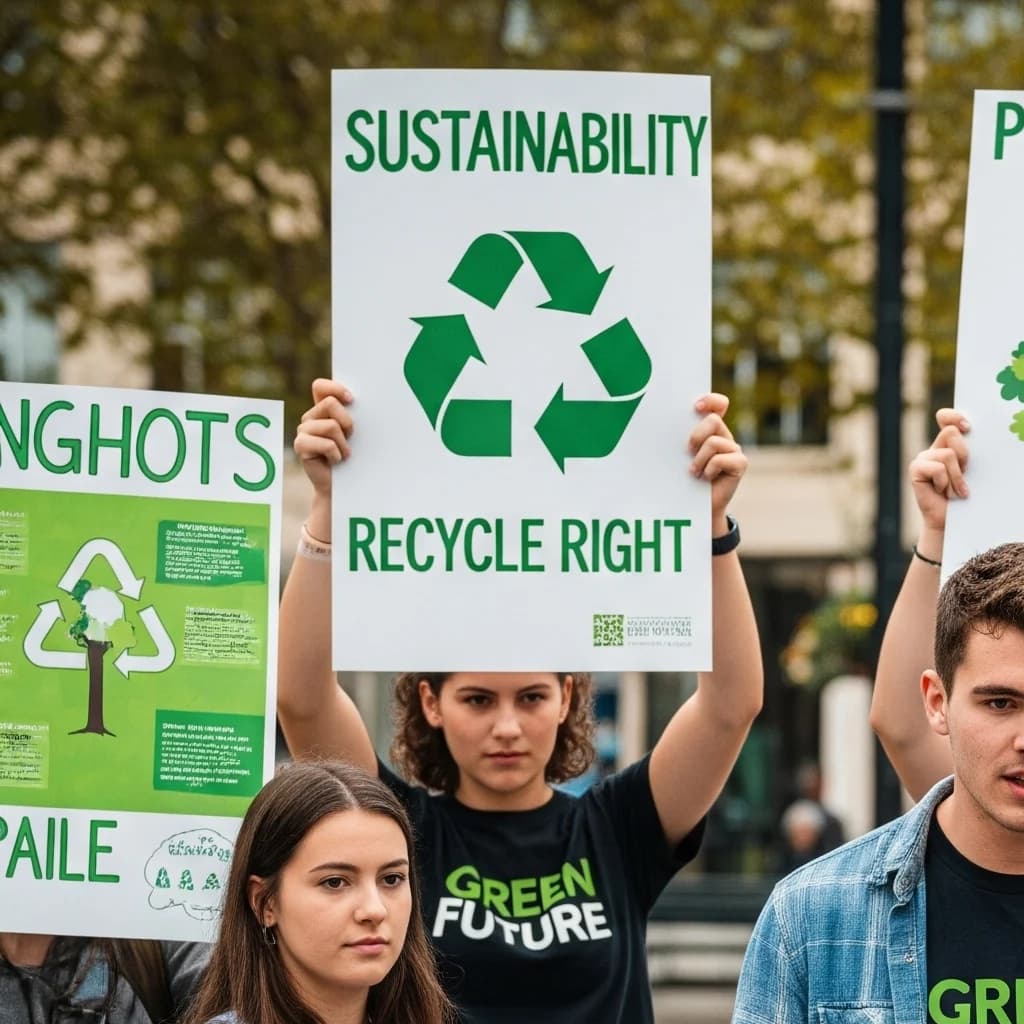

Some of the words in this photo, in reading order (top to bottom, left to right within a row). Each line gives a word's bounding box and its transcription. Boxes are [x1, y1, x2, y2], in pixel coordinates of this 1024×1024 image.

[345, 109, 708, 176] SUSTAINABILITY
[349, 517, 545, 572] RECYCLE
[561, 518, 692, 573] RIGHT
[445, 857, 596, 918] GREEN
[432, 897, 613, 951] FUTURE
